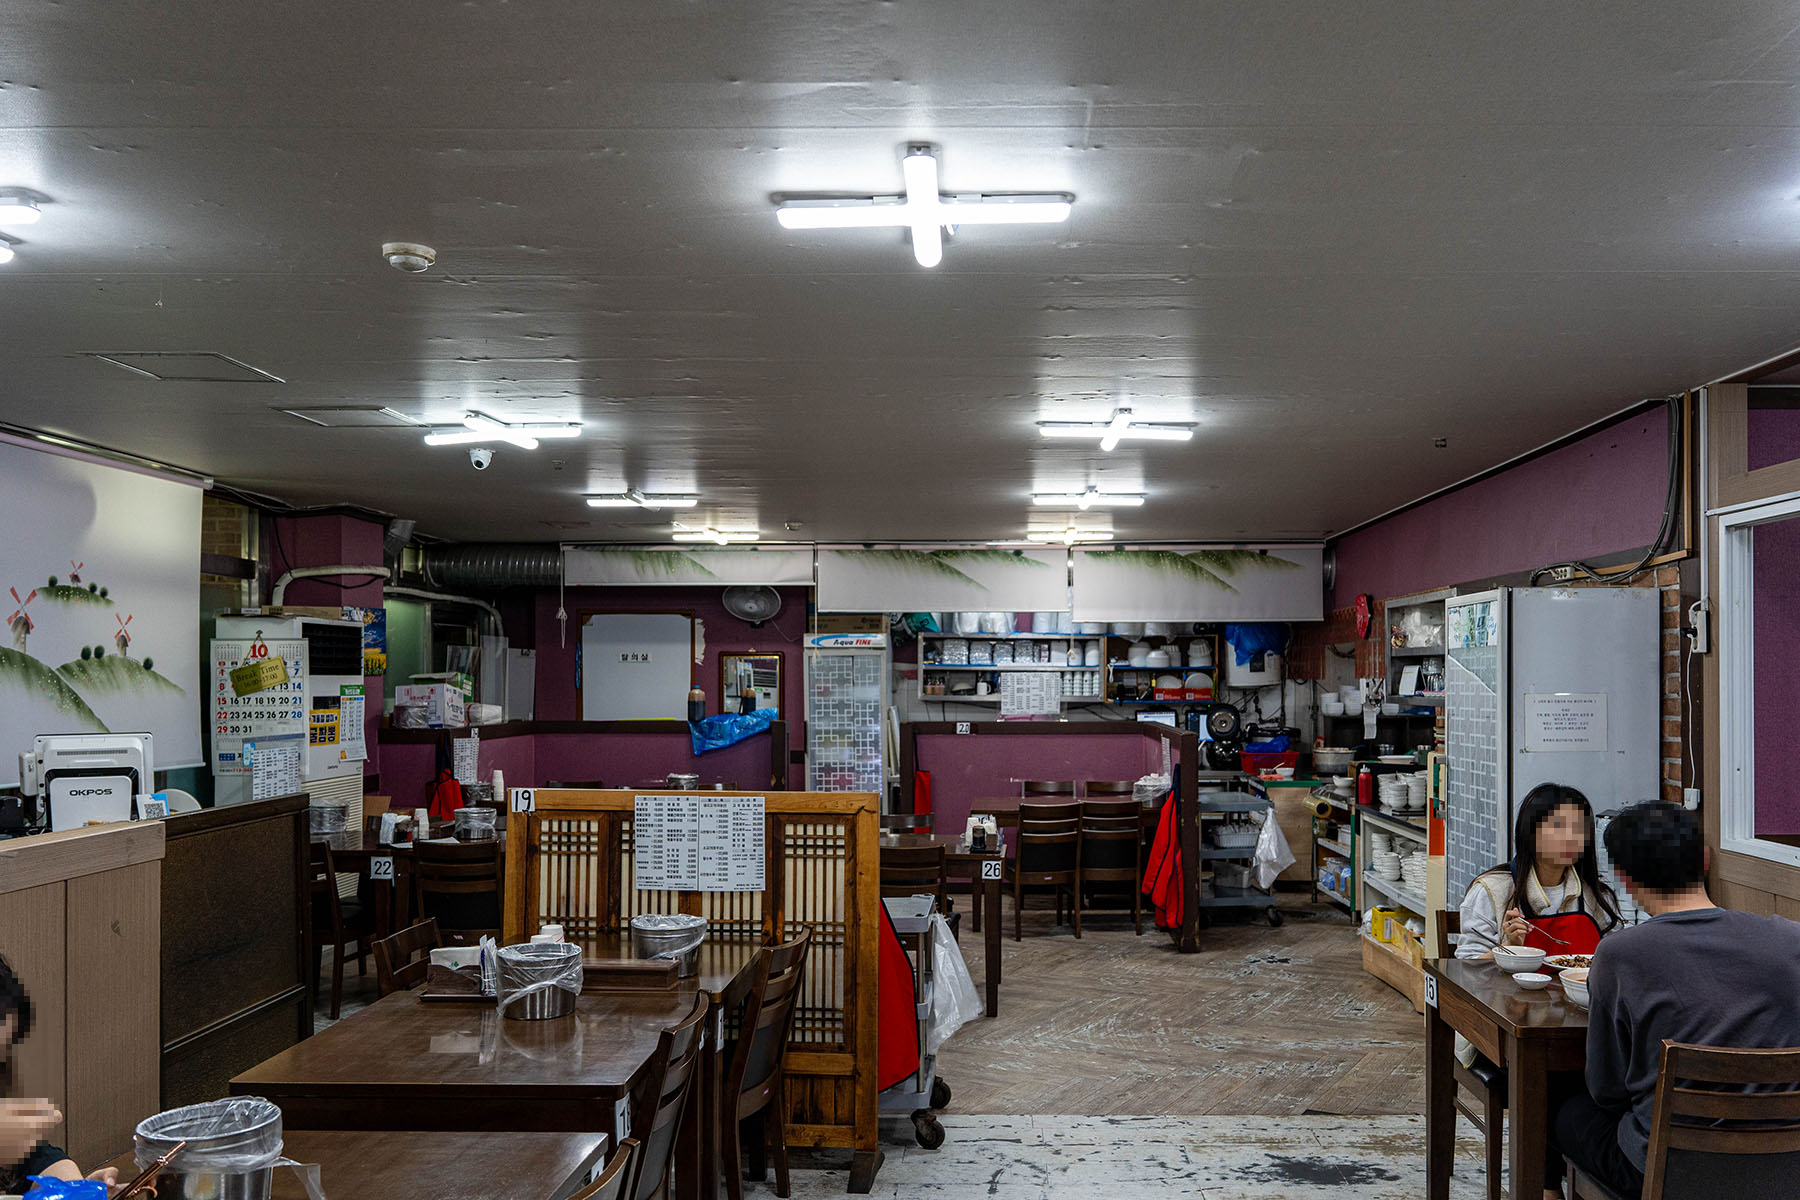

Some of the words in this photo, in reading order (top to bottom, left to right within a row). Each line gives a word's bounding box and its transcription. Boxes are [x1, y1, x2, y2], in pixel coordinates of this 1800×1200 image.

[250, 644, 268, 658] 10
[235, 670, 257, 682] Break
[260, 664, 280, 674] Time
[219, 683, 225, 691] 8
[217, 697, 226, 705] 15
[230, 697, 239, 705] 16
[242, 697, 251, 705] 17
[255, 697, 264, 705] 18
[267, 697, 276, 705] 19
[279, 697, 289, 705] 20
[292, 697, 302, 705] 21
[217, 711, 227, 719] 22
[229, 711, 240, 719] 23
[242, 711, 252, 719] 24
[254, 711, 264, 719] 25
[266, 711, 276, 719] 26
[279, 711, 289, 719] 27
[291, 711, 302, 719] 28
[515, 790, 531, 812] 19
[374, 861, 392, 875] 22
[984, 863, 1001, 878] 26
[1425, 974, 1436, 1000] 15
